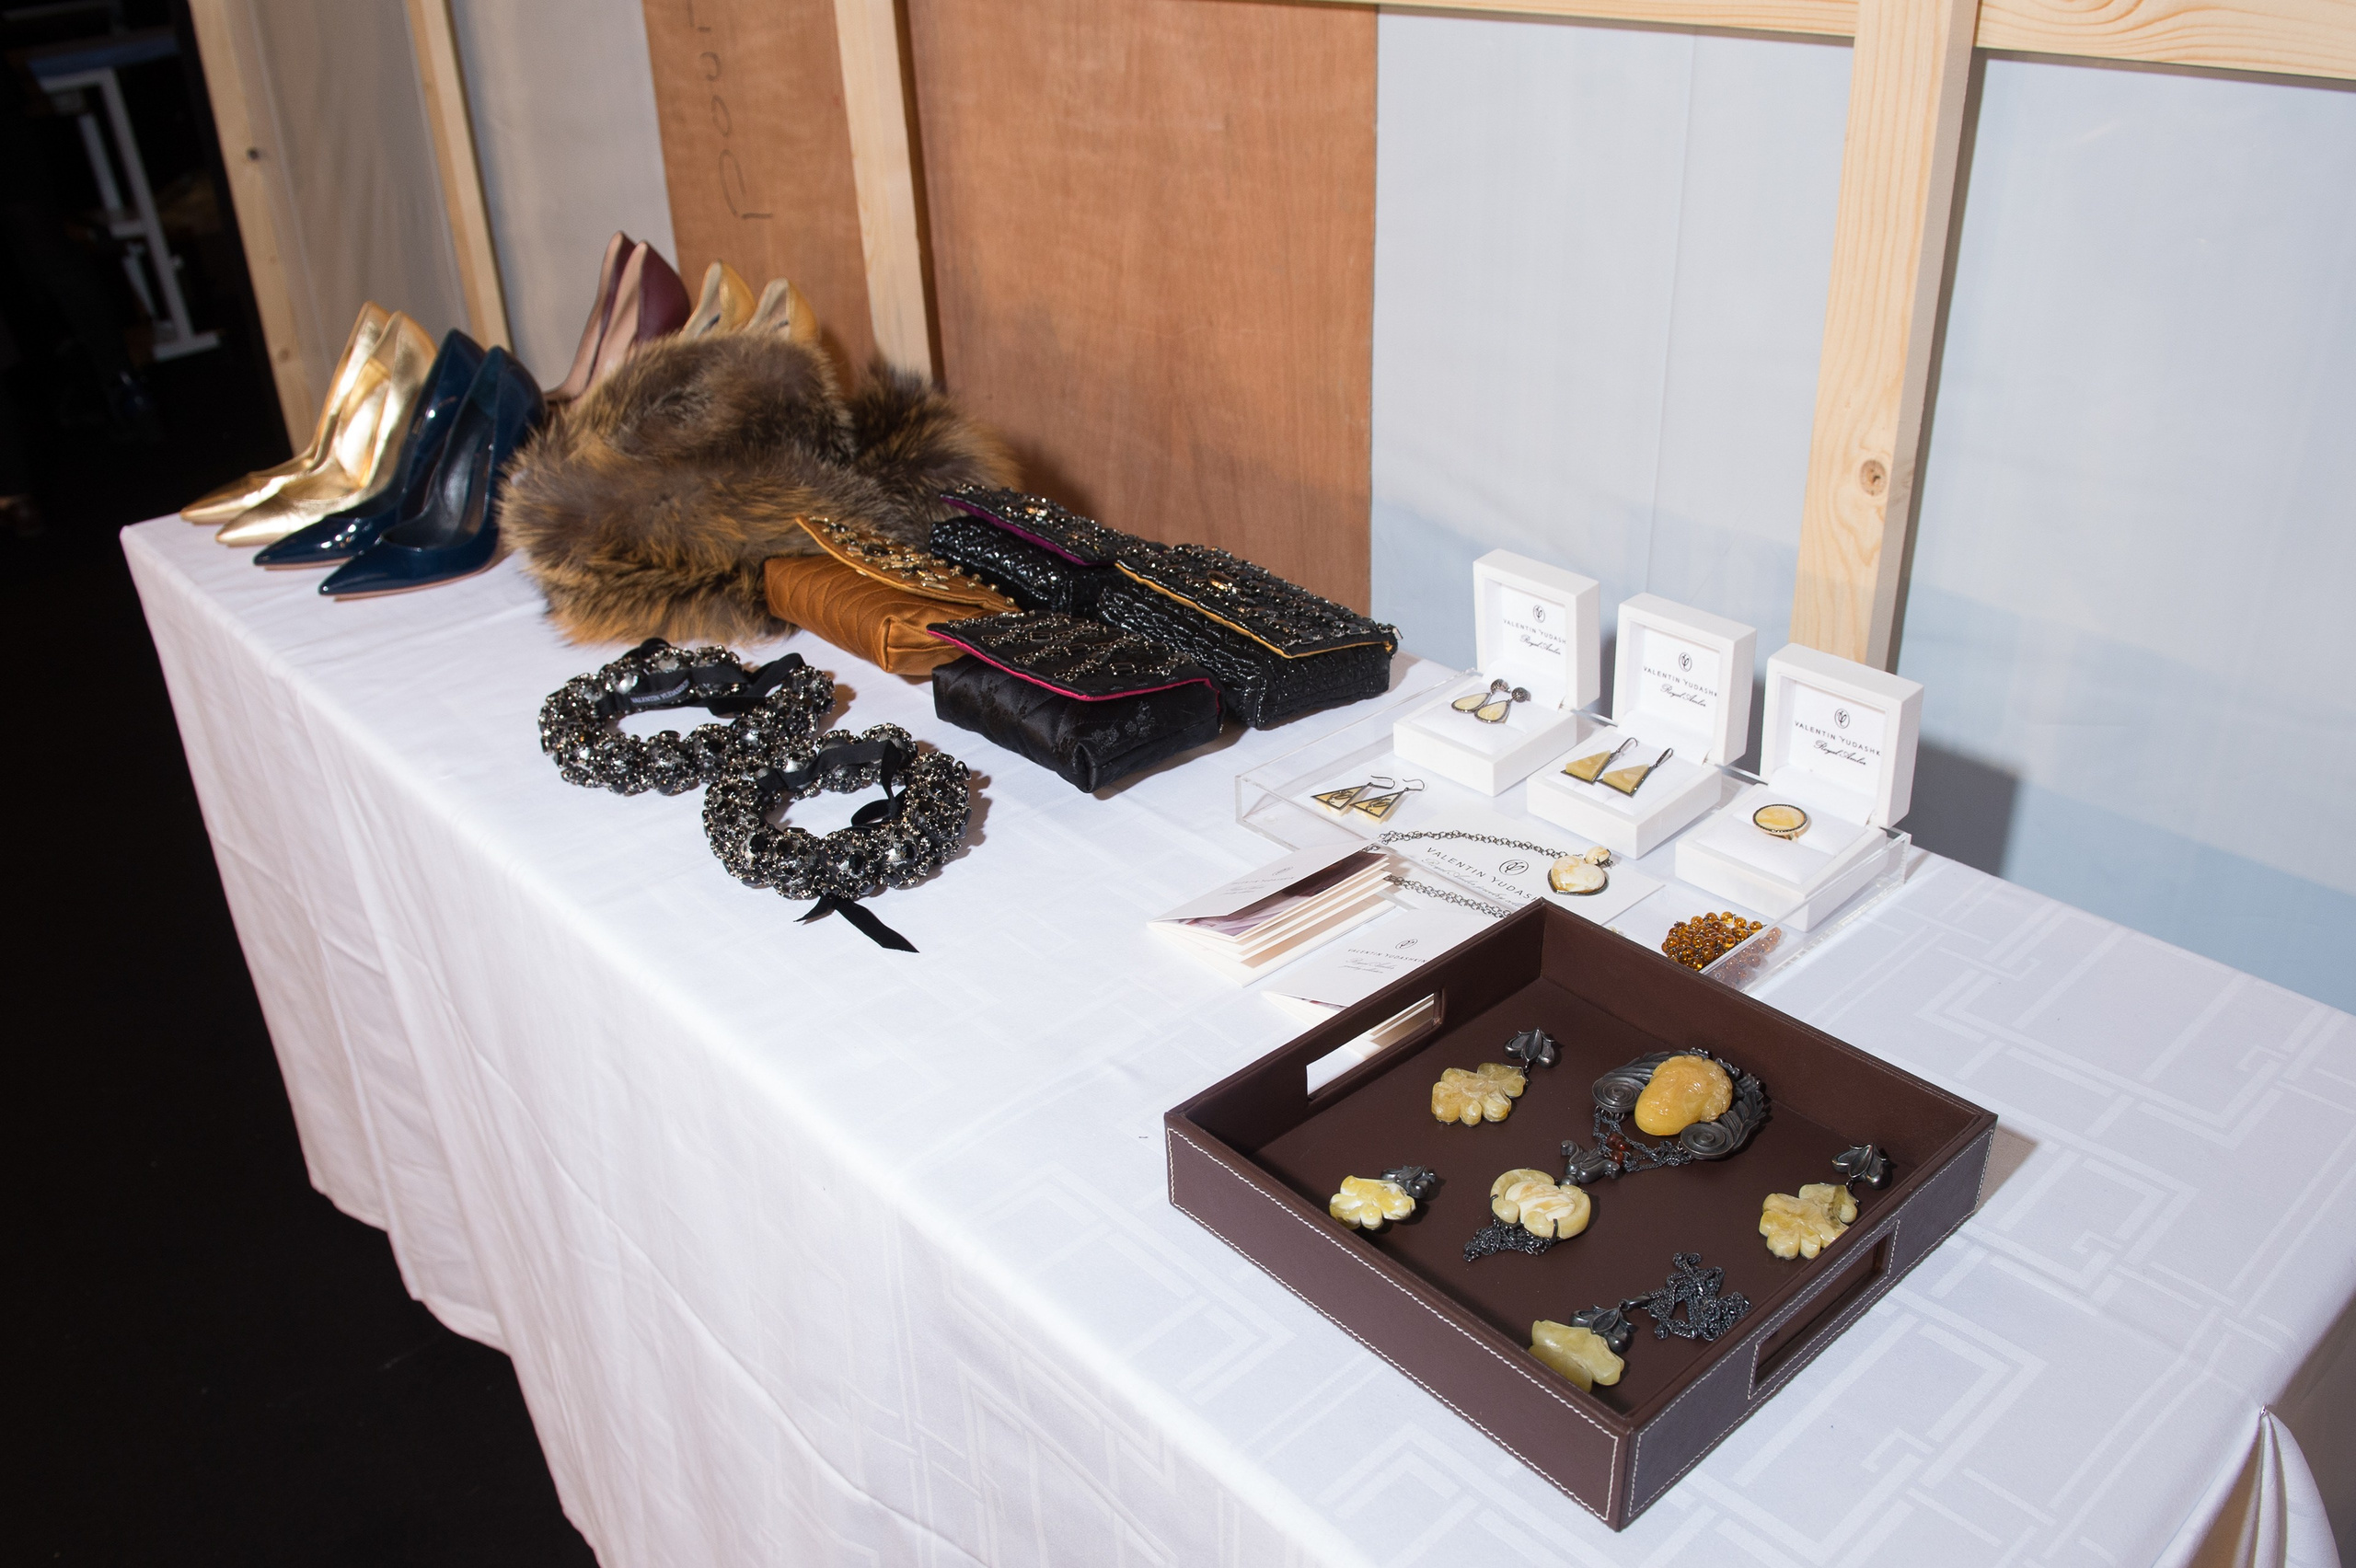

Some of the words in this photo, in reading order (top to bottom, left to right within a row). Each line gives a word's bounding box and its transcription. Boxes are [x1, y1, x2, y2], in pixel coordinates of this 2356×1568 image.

[1503, 618, 1537, 634] VALENTIN
[1643, 665, 1680, 684] VALENTIN
[1795, 721, 1836, 741] VALENTIN
[1813, 739, 1843, 755] Royal
[1426, 847, 1487, 878] VALENTIN
[1347, 948, 1383, 957] VALENTIN
[1384, 953, 1427, 963] YUDASHKIN
